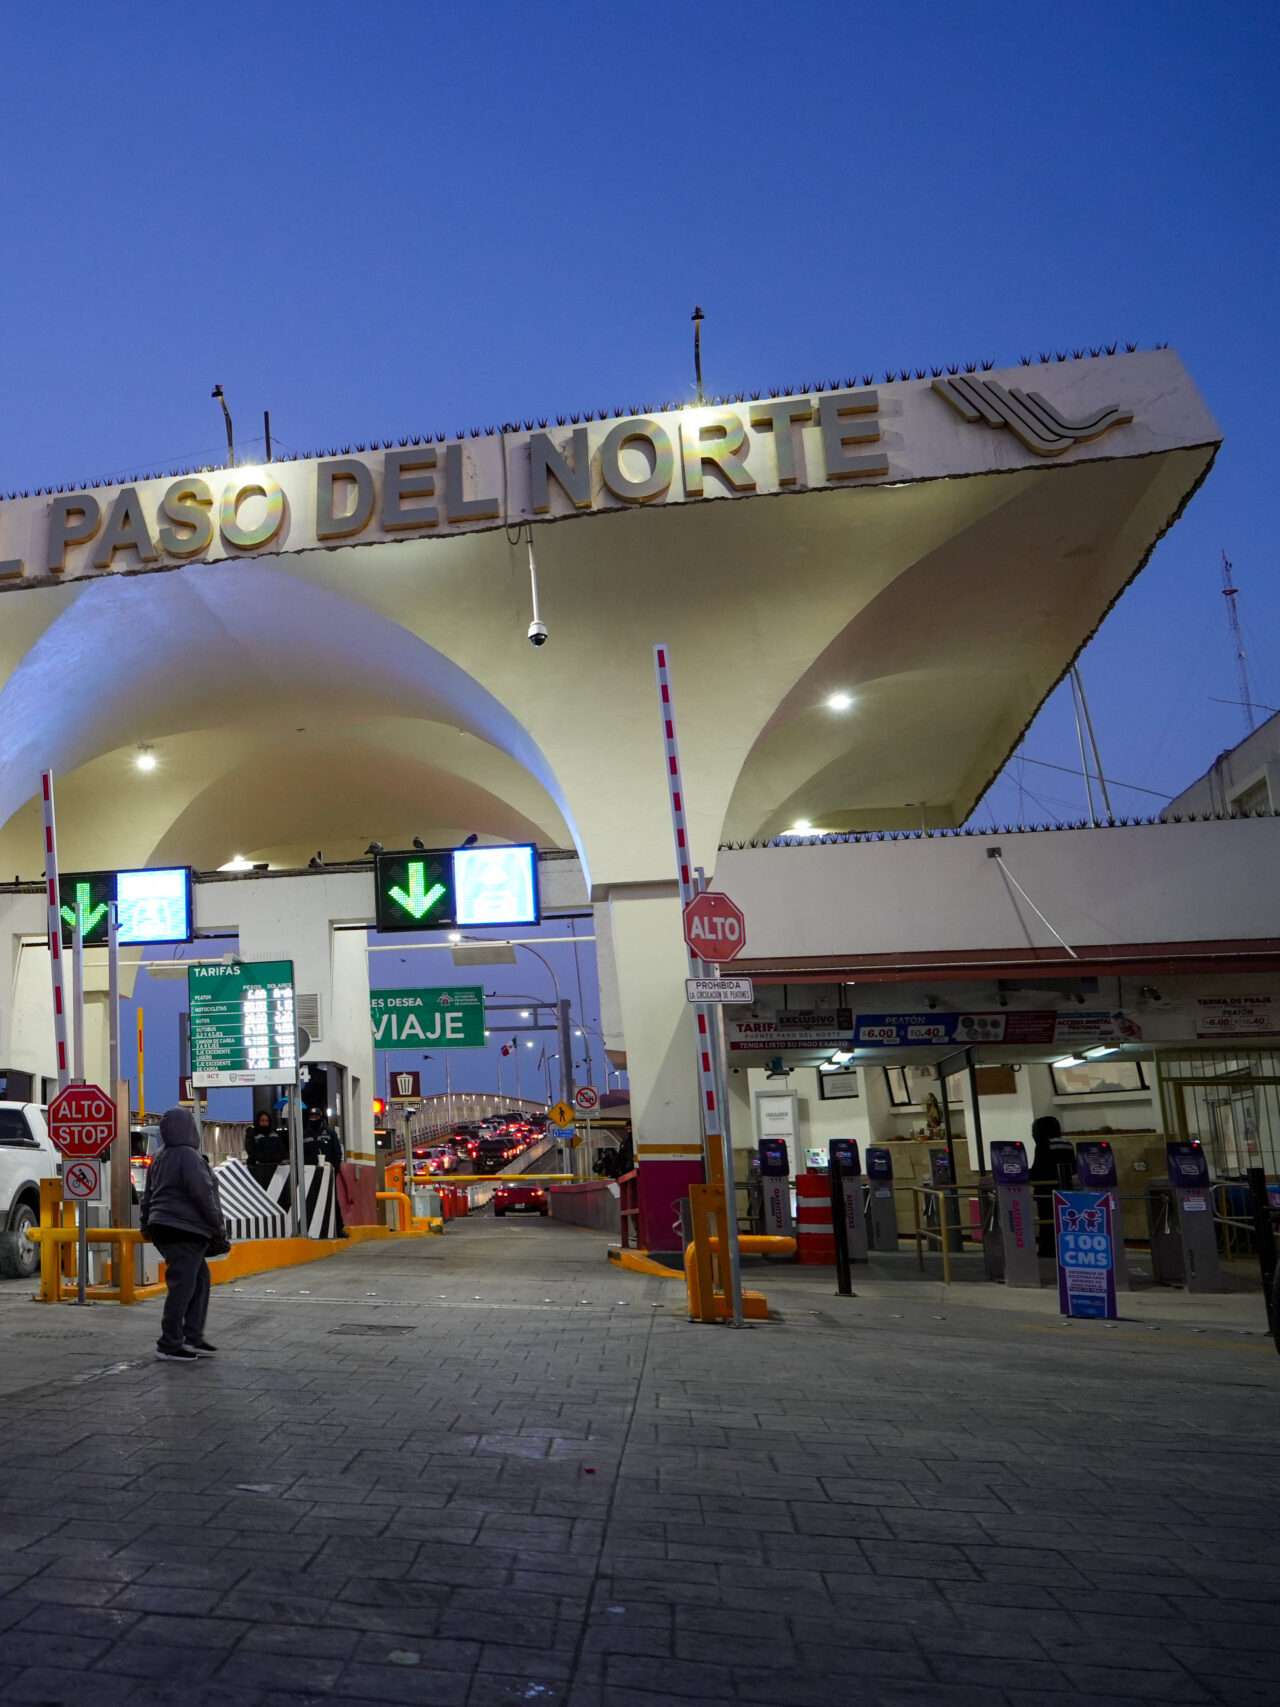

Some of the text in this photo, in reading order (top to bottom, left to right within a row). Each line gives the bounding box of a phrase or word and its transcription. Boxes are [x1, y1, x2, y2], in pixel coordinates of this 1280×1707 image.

[47, 469, 289, 574] PASO
[317, 444, 500, 541] DEL
[529, 389, 889, 514] NORTE
[690, 915, 740, 941] ALTO
[193, 966, 240, 977] TARIFAS
[696, 981, 741, 990] PROHIBIDA
[370, 998, 423, 1008] ES DESEA
[371, 1012, 464, 1041] VIAJE
[779, 1015, 835, 1025] EXCLUSIVO
[58, 1101, 105, 1120] ALTO
[59, 1126, 109, 1146] STOP
[1064, 1234, 1107, 1251] 100
[1064, 1250, 1109, 1266] CMS
